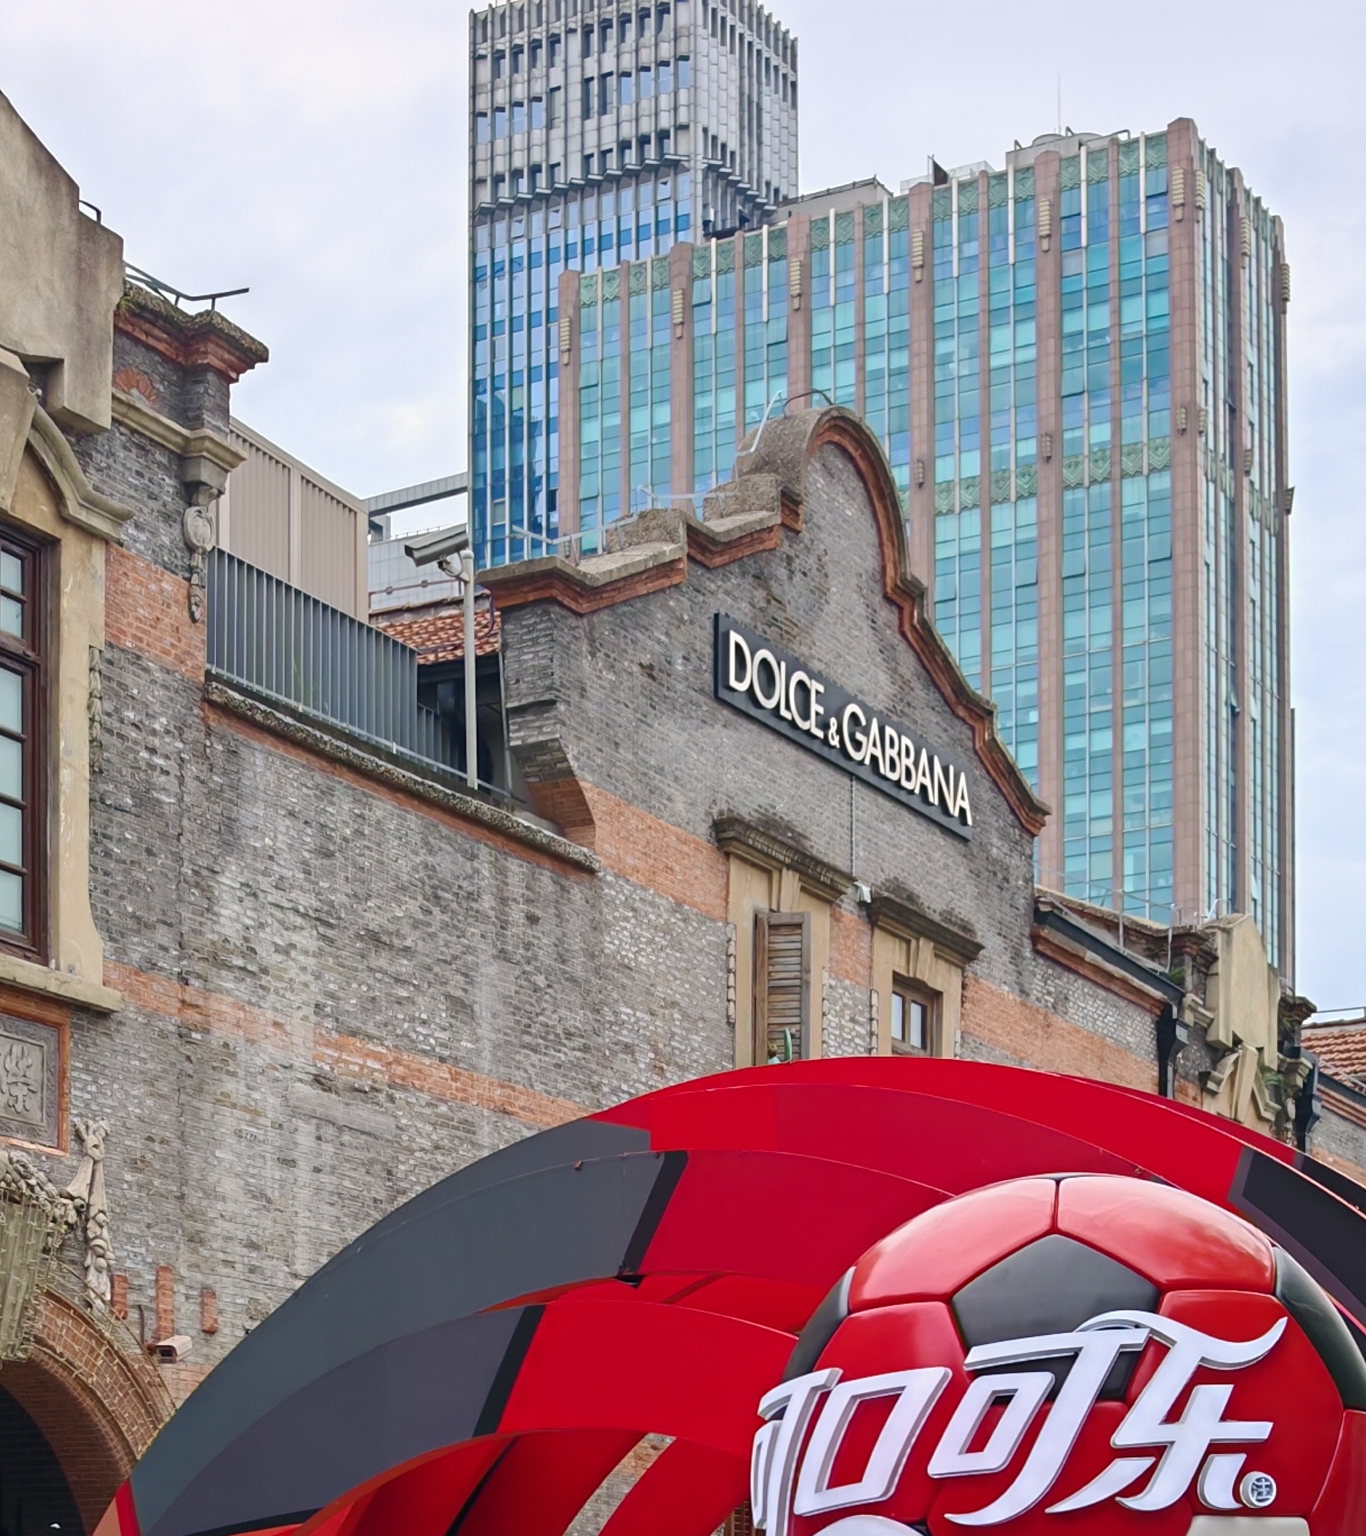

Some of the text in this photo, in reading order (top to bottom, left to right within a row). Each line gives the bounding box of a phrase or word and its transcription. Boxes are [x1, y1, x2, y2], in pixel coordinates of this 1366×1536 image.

[729, 629, 973, 826] DOLCE & GABBANA
